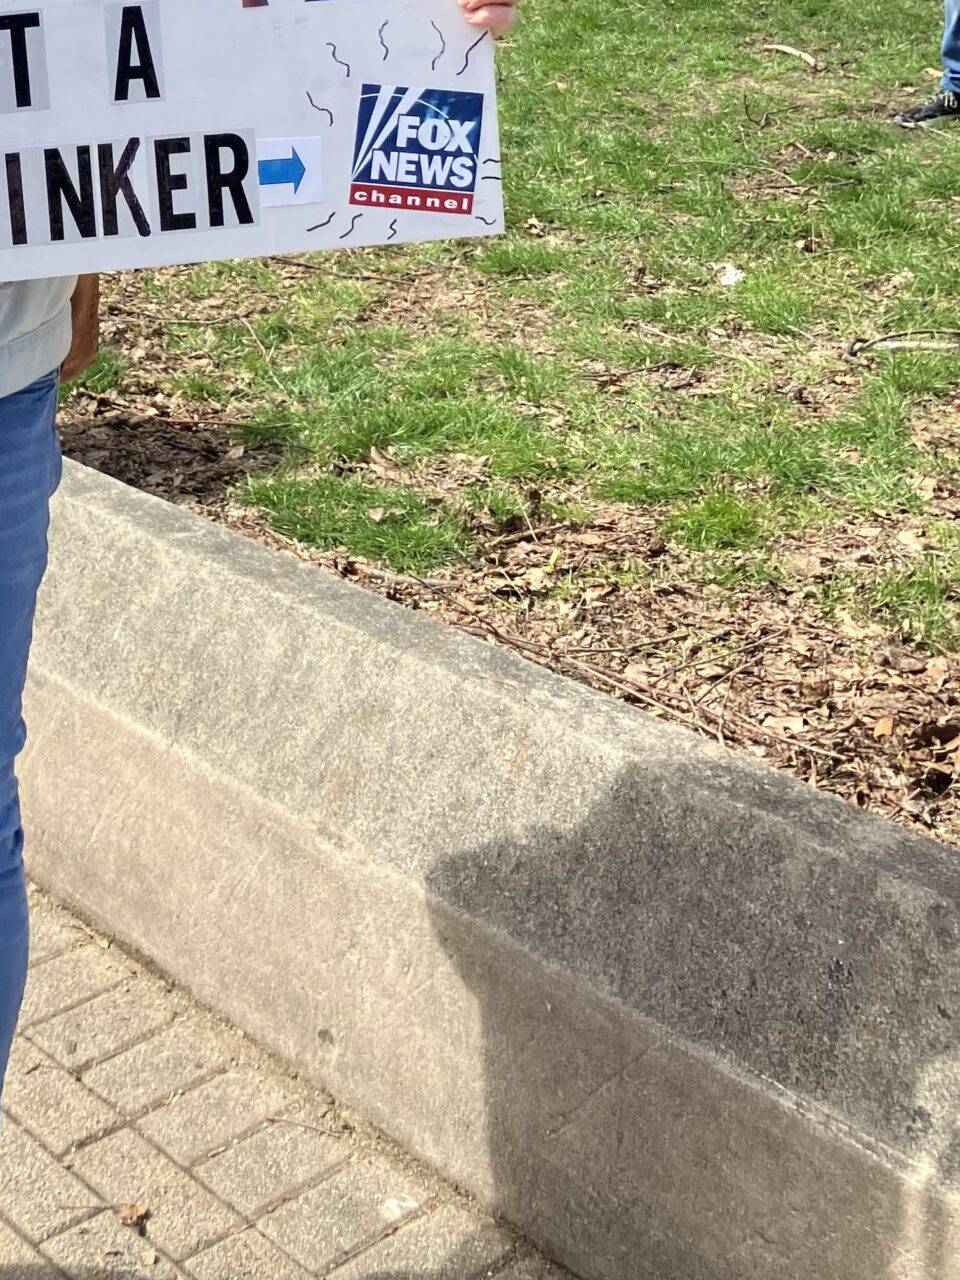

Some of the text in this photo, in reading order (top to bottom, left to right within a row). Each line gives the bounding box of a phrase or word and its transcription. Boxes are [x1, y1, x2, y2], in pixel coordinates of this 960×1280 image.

[114, 5, 161, 102] A
[396, 115, 476, 154] FOX
[370, 150, 474, 188] NEWS
[353, 189, 469, 211] channel
